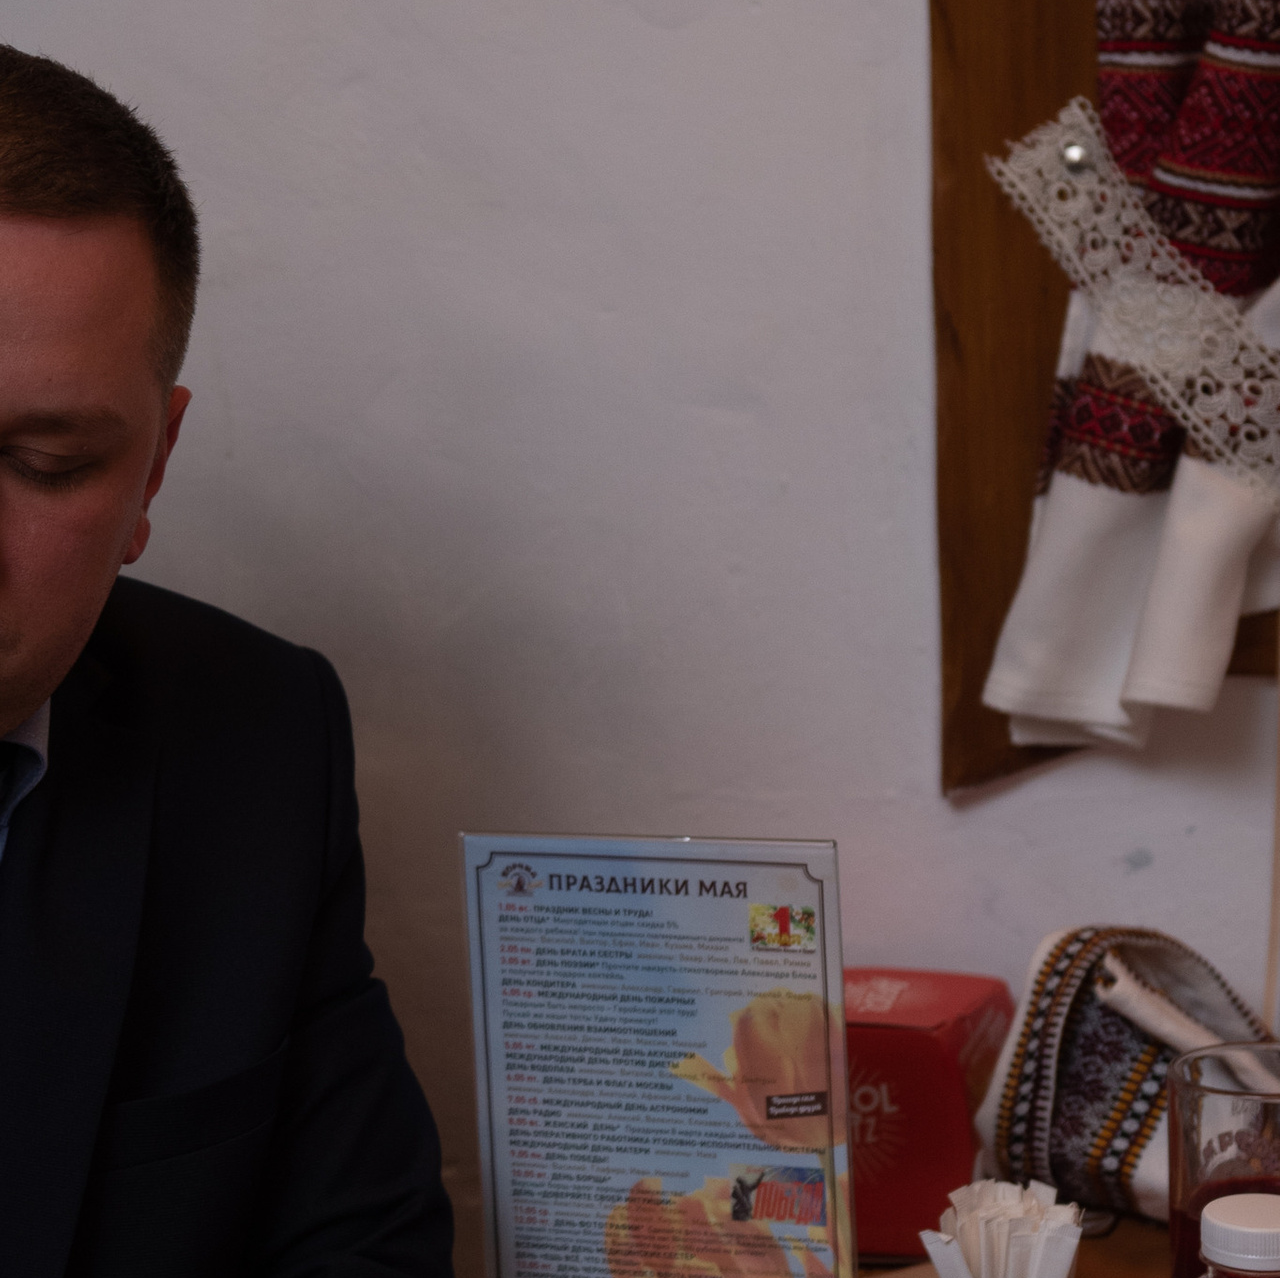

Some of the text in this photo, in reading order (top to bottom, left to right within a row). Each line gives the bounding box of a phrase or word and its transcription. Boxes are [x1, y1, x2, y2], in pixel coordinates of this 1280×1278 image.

[547, 873, 747, 898] ПРАЗДНИКИ МАЯ
[533, 904, 579, 915] ПРАЗДНИК
[581, 906, 613, 917] ВЕСНЫ
[613, 907, 621, 917] И
[497, 913, 521, 924] ДЕНЬ
[534, 946, 559, 956] ДЕНЬ
[559, 947, 588, 957] БРАТА
[535, 958, 559, 968] ДЕНЬ
[500, 978, 525, 987] ДЕНЬ
[537, 990, 618, 1002] МЕЖДУНАРОДНЫЙ
[619, 994, 643, 1003] ДЕНЬ
[644, 995, 696, 1006] ПОЖАРНЫХ
[502, 1020, 677, 1037] ДЕНЬ ОБНОВЛЕНИЯ ВЗАИМООТНОШЕНИЙ
[539, 1043, 620, 1055] МЕЖДУНАРОДНЫЙ
[621, 1047, 645, 1056] ДЕНЬ
[504, 1052, 585, 1064] МЕЖДУНАРОДНЫЙ
[586, 1056, 610, 1066] ДЕНЬ
[541, 1075, 566, 1085] ДЕНЬ
[541, 1097, 622, 1110] МЕЖДУНАРОДНЫЙ
[623, 1101, 647, 1111] ДЕНЬ
